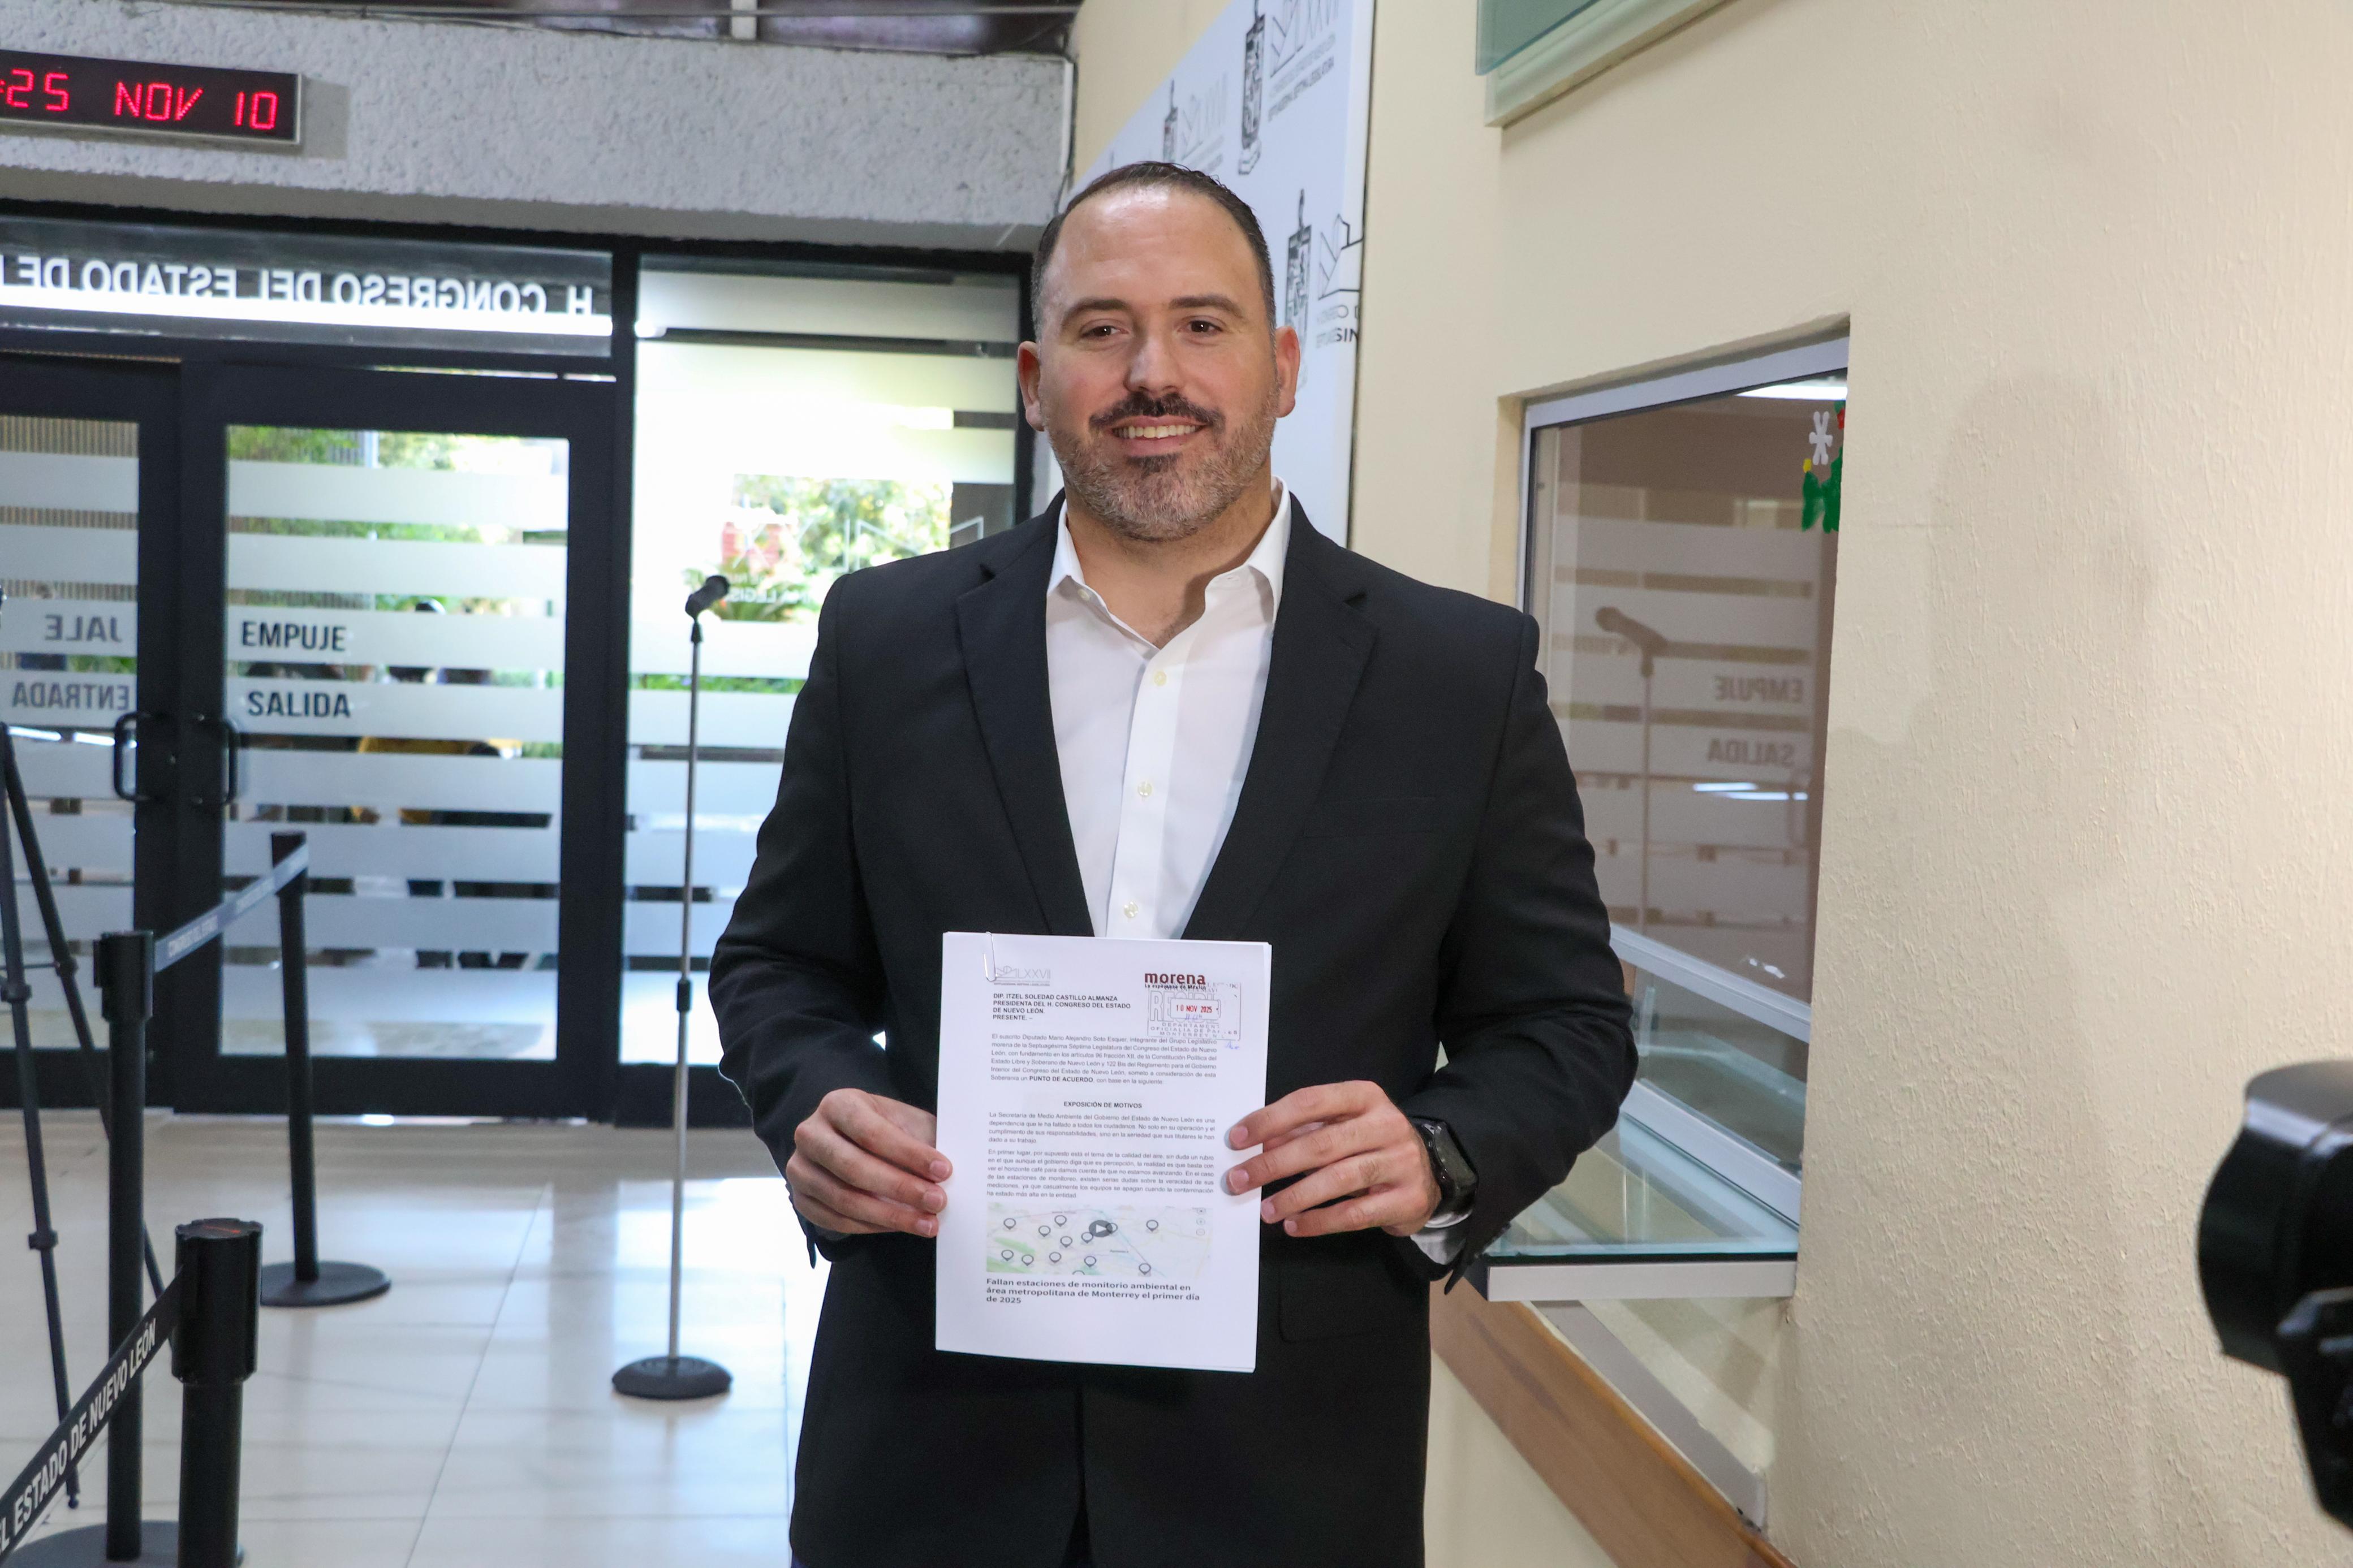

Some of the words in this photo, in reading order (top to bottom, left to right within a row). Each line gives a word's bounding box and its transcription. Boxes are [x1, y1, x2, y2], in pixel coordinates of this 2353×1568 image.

[115, 81, 204, 121] NOV
[234, 91, 278, 130] 10
[242, 621, 346, 651] EMPUJE
[248, 691, 351, 719] SALIDA
[1144, 973, 1206, 985] morena
[1008, 1288, 1075, 1298] metropolitana
[1092, 1290, 1139, 1301] Monterrey
[1152, 1292, 1182, 1302] primer
[1016, 1279, 1066, 1288] estaciones
[1081, 1281, 1128, 1289] monitorio
[14, 1440, 68, 1535] ESTADO
[68, 1411, 87, 1460] DE
[89, 1359, 127, 1429] NUEVO
[130, 1318, 157, 1379] LEÓN
